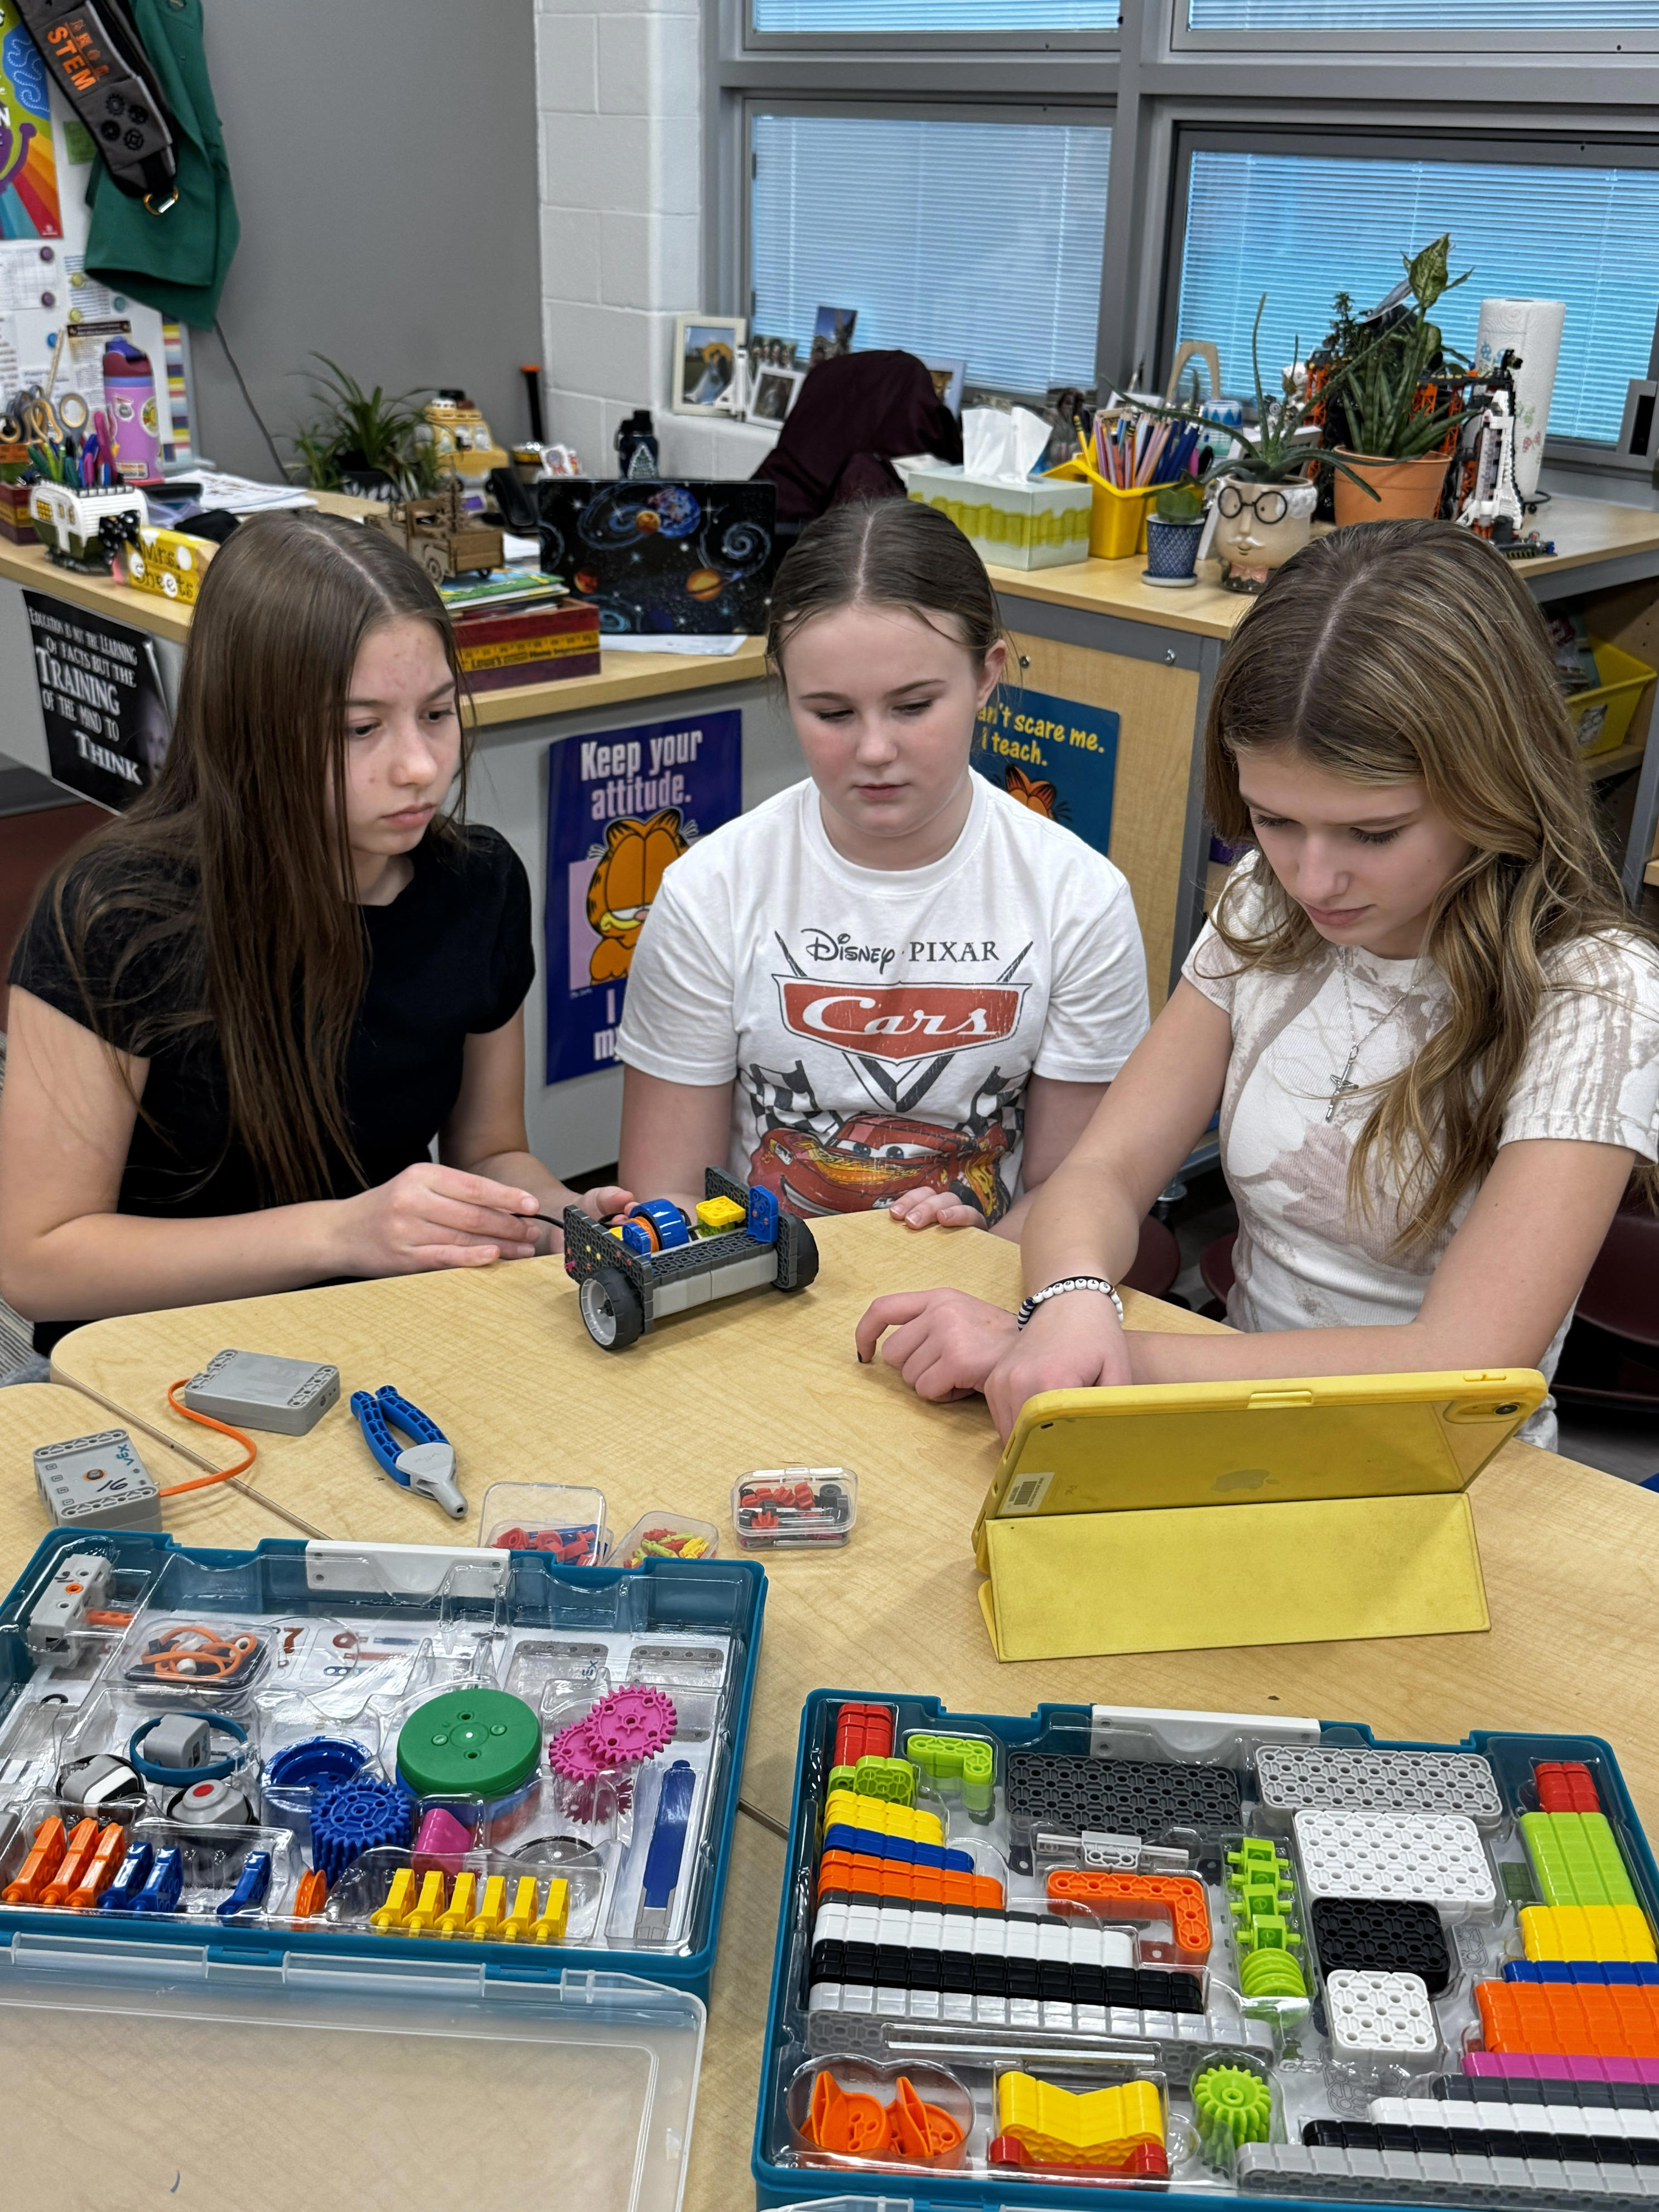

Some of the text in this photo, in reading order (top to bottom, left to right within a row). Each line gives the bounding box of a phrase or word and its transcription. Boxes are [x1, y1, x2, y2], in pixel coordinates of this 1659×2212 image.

[47, 27, 97, 91] STEM
[35, 645, 120, 716] TRAINING
[57, 640, 91, 670] FACTS
[91, 655, 111, 678] BUT
[112, 663, 137, 688] THE
[57, 695, 77, 722] THE
[77, 702, 102, 734] MIND
[103, 716, 120, 742] TO
[977, 702, 1105, 754] an't scare me.
[72, 728, 143, 786] THINK
[581, 730, 703, 783] Keep your
[981, 726, 1048, 767] I teach.
[591, 770, 692, 821] attitude.
[908, 941, 1000, 963] PIXAR
[607, 988, 615, 1024] I
[802, 996, 998, 1036] Cars
[116, 1443, 134, 1466] VEX
[97, 1477, 129, 1493] 16
